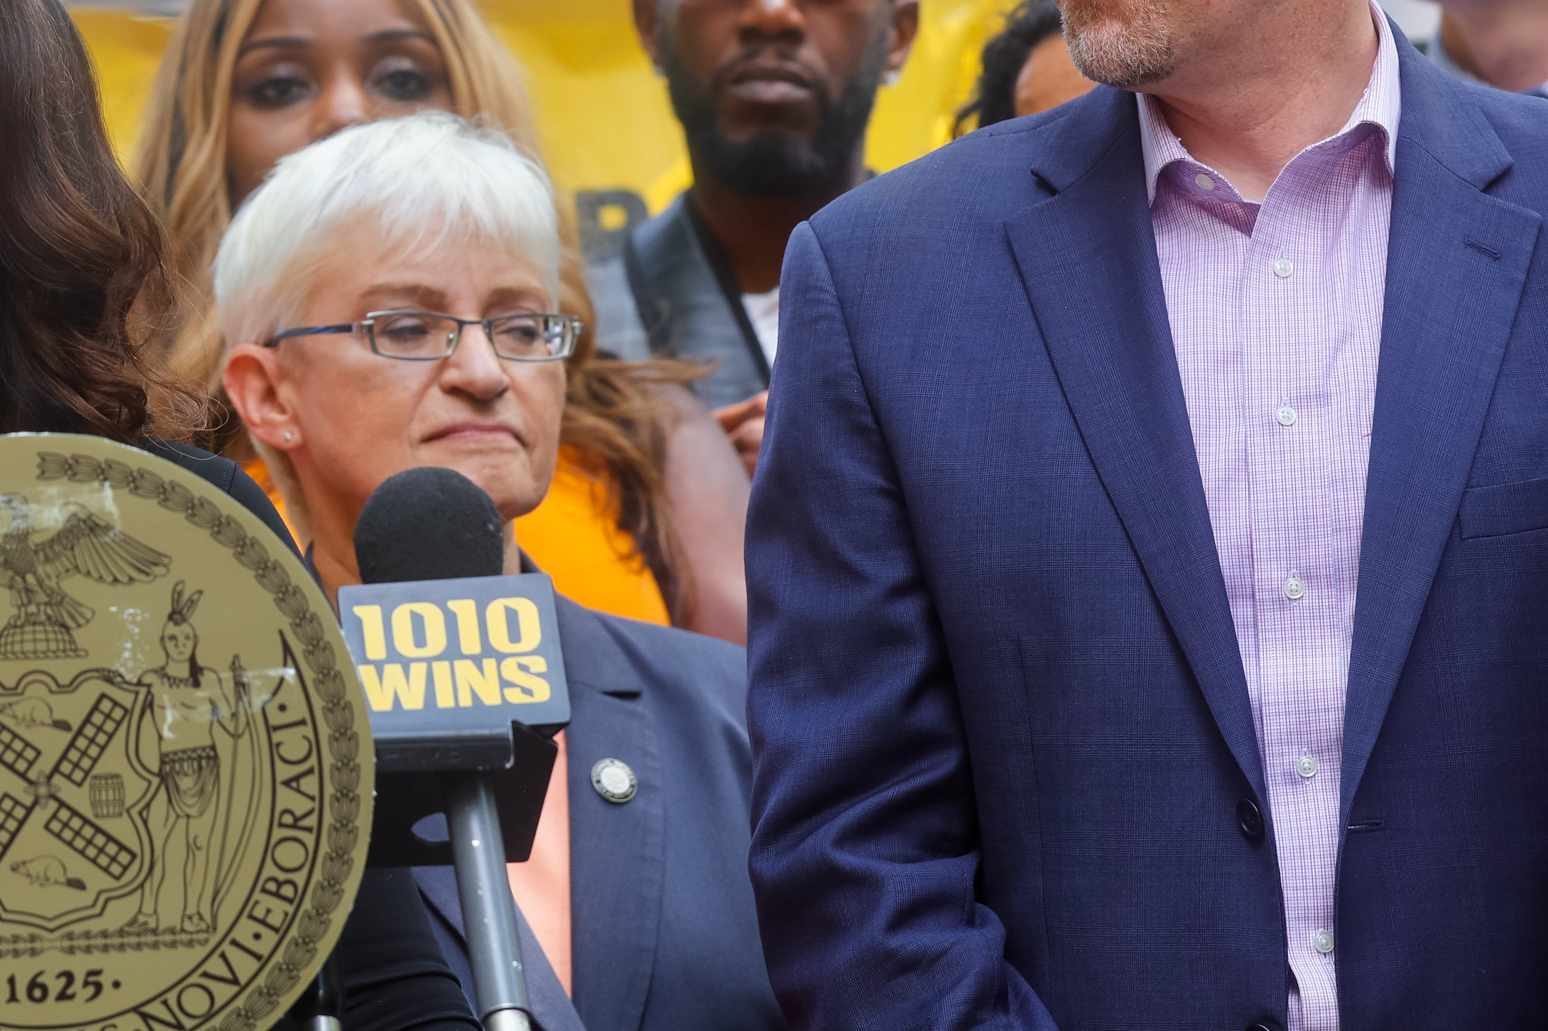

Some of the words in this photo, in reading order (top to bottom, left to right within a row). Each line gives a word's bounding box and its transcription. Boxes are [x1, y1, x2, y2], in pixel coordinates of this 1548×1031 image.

[352, 596, 542, 660] 1010
[357, 655, 551, 712] WINS
[133, 938, 265, 1031] NOVI
[246, 717, 316, 943] EBORACI
